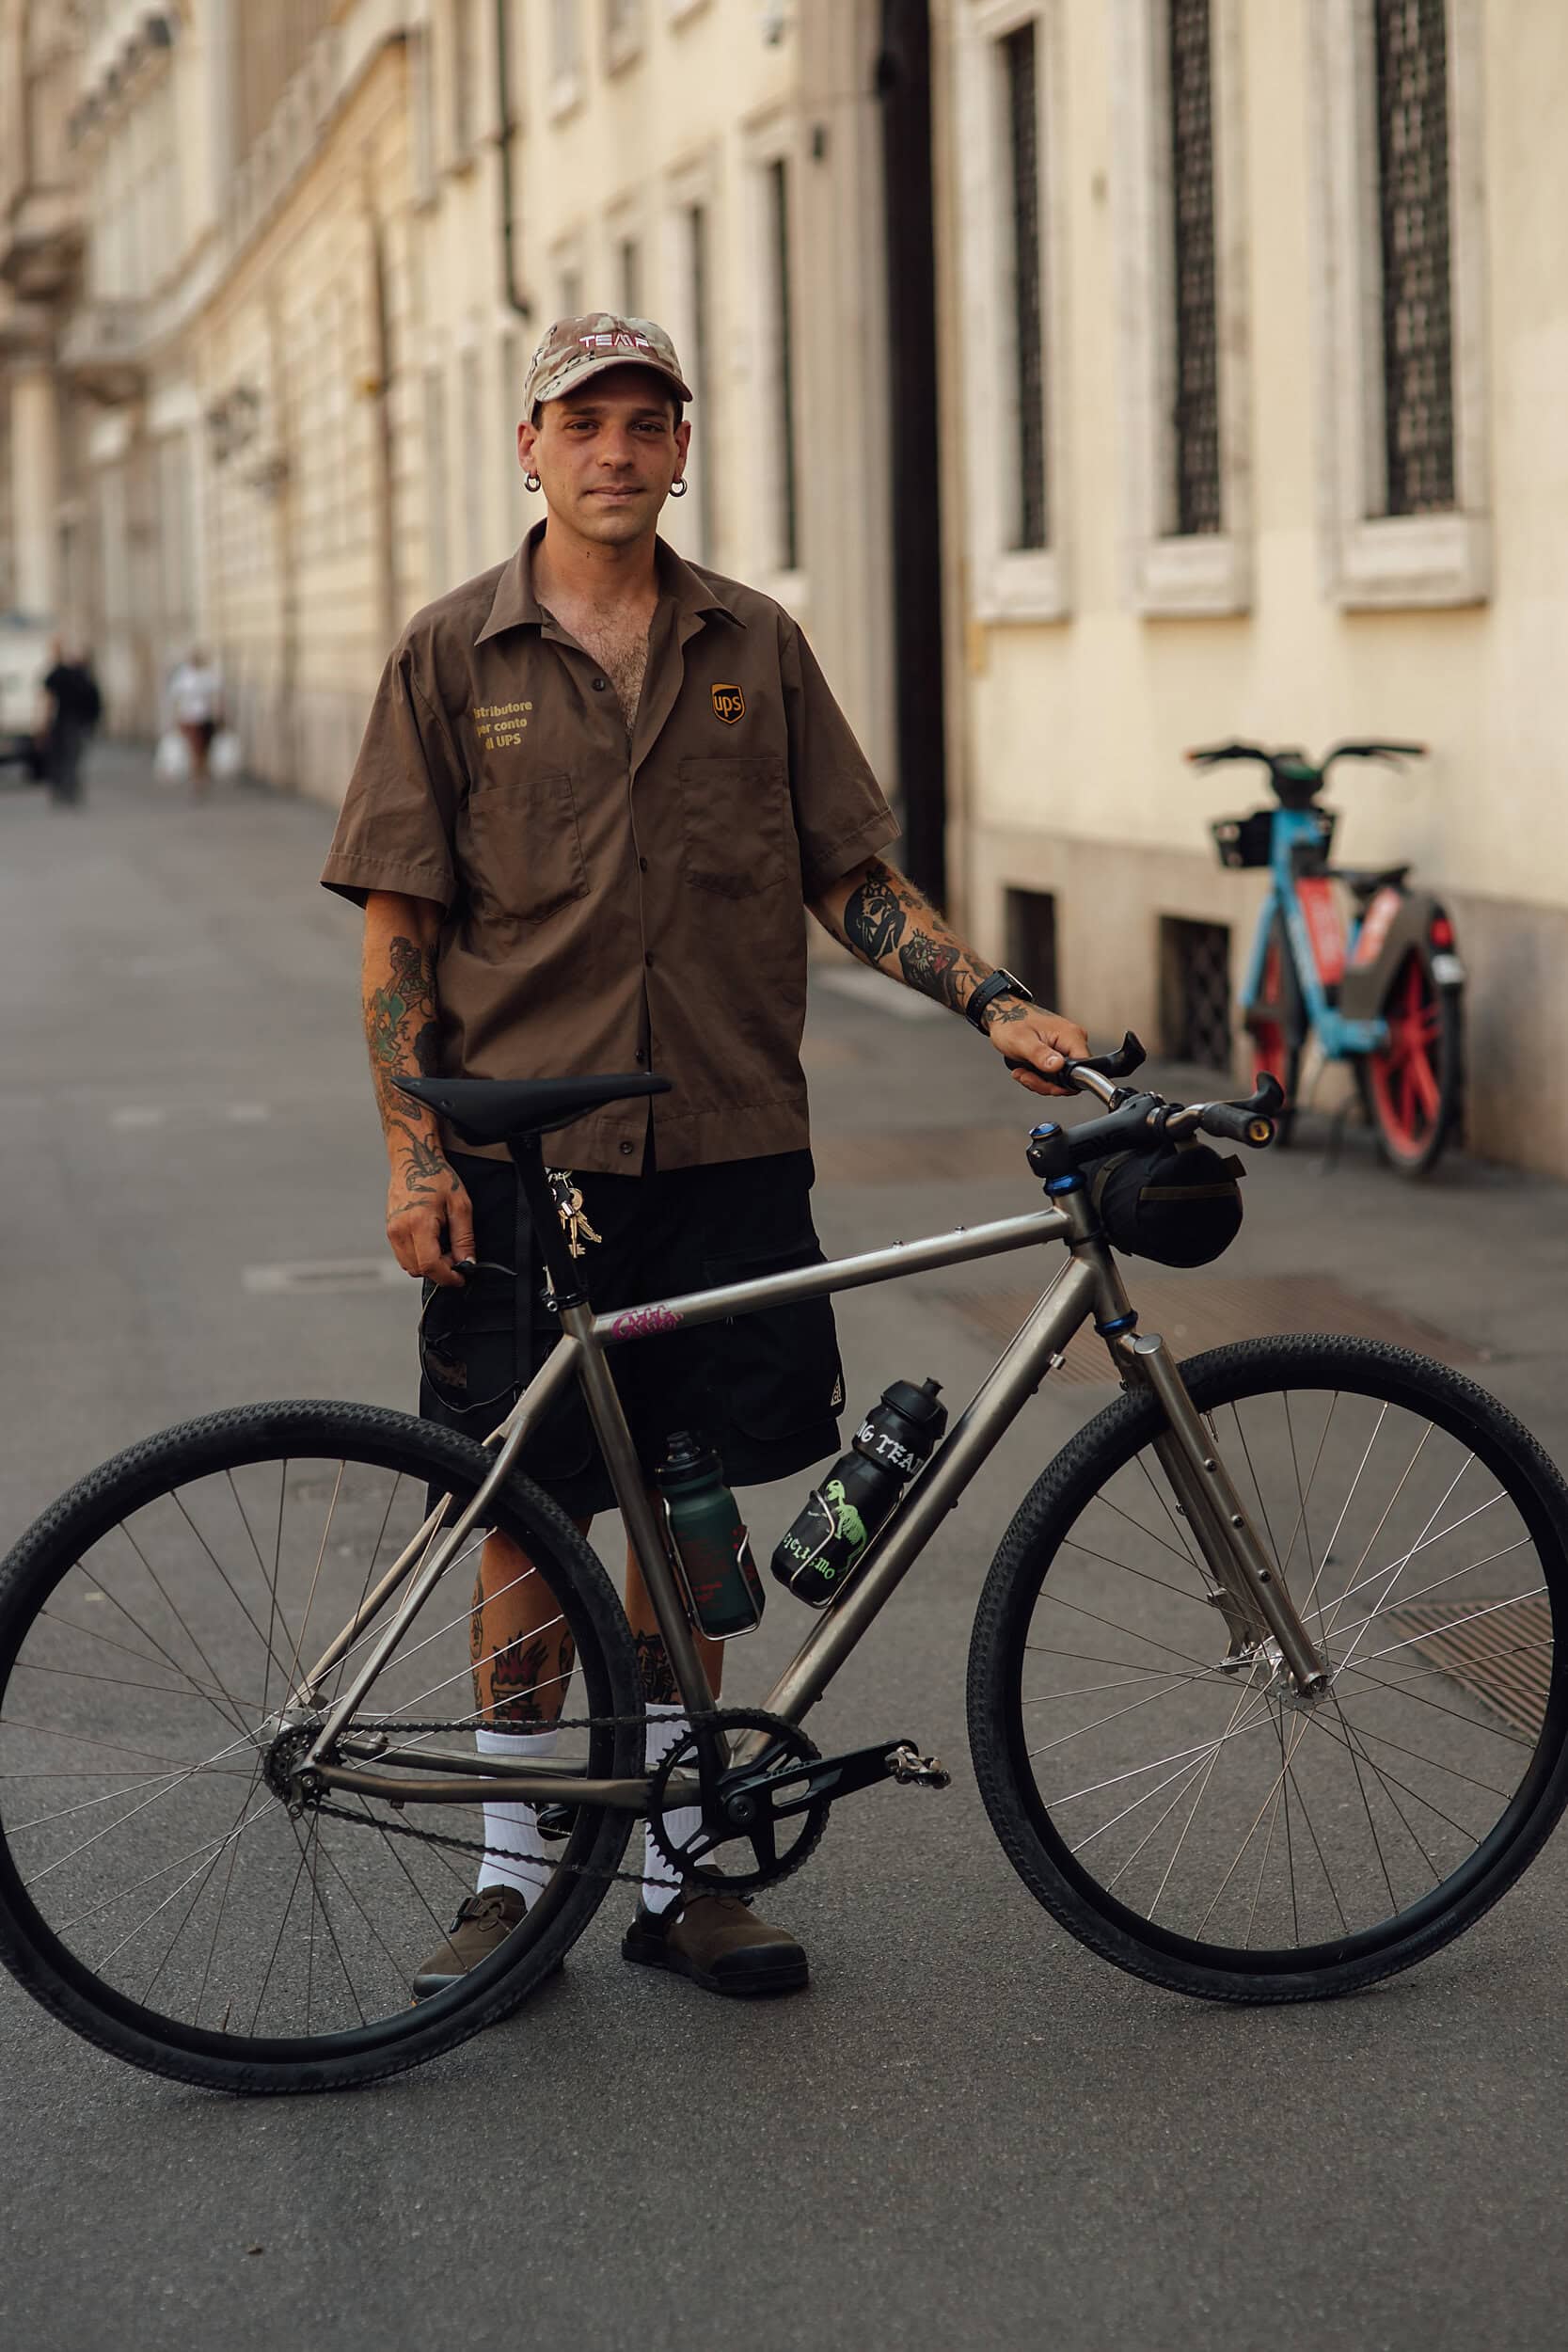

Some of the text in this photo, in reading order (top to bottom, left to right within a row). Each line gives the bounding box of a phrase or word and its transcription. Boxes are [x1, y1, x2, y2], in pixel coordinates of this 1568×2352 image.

[714, 695, 742, 718] ups
[494, 718, 528, 732] conto
[496, 733, 522, 747] UPS
